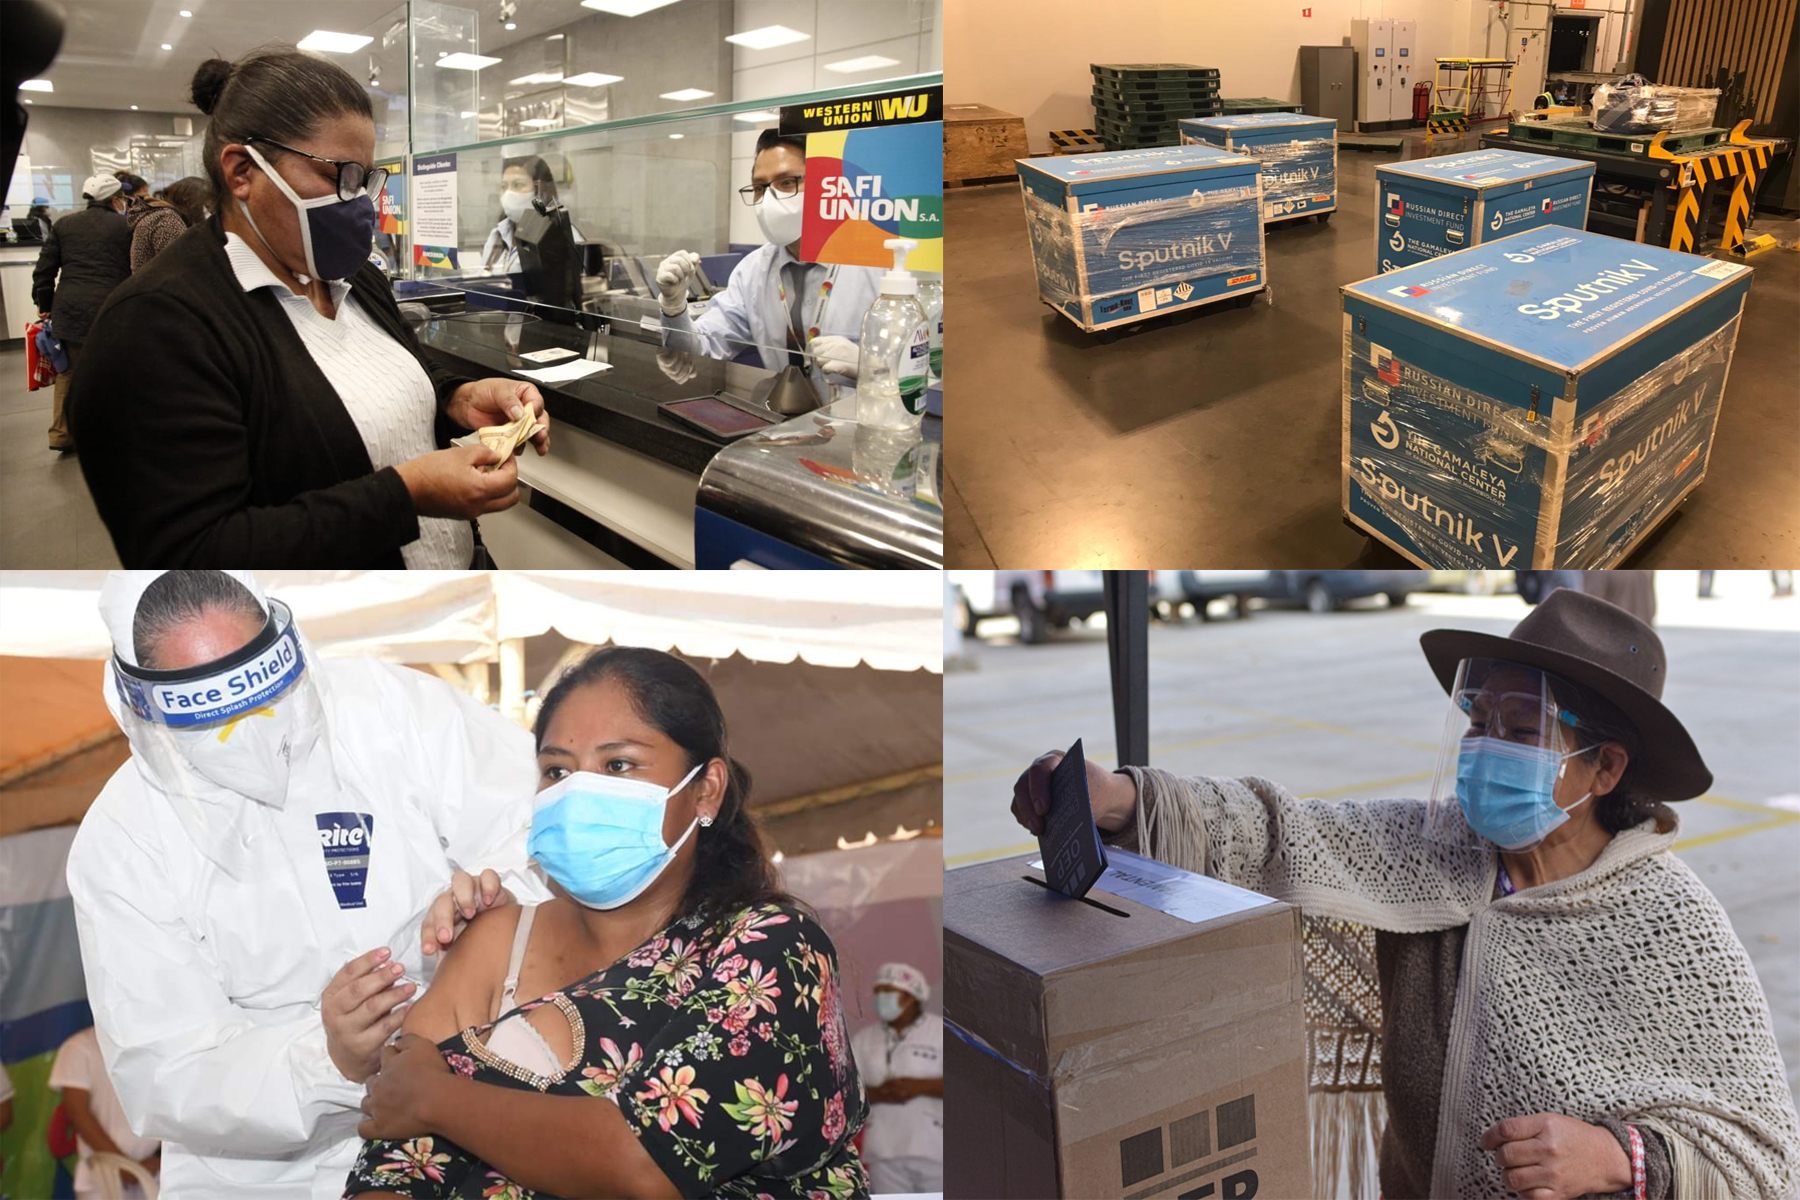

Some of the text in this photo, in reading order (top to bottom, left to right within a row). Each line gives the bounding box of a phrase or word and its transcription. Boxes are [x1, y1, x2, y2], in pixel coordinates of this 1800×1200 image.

[804, 101, 872, 118] WESTERN
[823, 112, 872, 126] UNION
[881, 94, 928, 120] WU
[820, 175, 882, 198] SAFI
[1262, 166, 1319, 188] putnik V
[382, 195, 394, 205] SAFI
[382, 204, 402, 215] UNION
[820, 198, 940, 222] UNION S.A.
[1105, 198, 1162, 211] RUSSIAN DIRECT
[1406, 202, 1465, 221] RUSSIAN DIRECT
[1514, 205, 1536, 214] GAMALEYA
[1552, 197, 1569, 205] RUSSIAN
[1405, 211, 1465, 230] INVESTMENT FUND
[1504, 213, 1522, 221] NATIONAL
[1118, 232, 1232, 271] Sputnik V
[1407, 244, 1434, 256] NATIONAL
[1036, 257, 1070, 292] Sputnik
[1152, 266, 1186, 277] REGISTERED
[1232, 276, 1253, 284] DHL
[1420, 263, 1487, 287] RUSSIAN DIRECT
[1430, 266, 1499, 290] INVESTMENT FUND
[1518, 258, 1659, 320] Sputnik V
[1566, 270, 1686, 329] THE FIRST REGISTERED COVID-19 VACCINE
[1582, 273, 1698, 334] PROVEN HUMAN ADENOVIRAL VECTOR TECHNOLOGY
[1404, 366, 1461, 400] RUSSIAN
[1403, 381, 1479, 424] INVESTMENT
[1599, 400, 1690, 495] Sputnik
[1694, 383, 1707, 414] V
[1405, 441, 1506, 501] NATIONAL CENTER
[1406, 430, 1507, 491] THE GAMALEYA
[1462, 481, 1506, 507] MICROBIOLOGY
[1360, 457, 1484, 553] Sputnik
[1492, 533, 1519, 567] V
[162, 688, 222, 708] Face
[228, 641, 293, 696] Shield
[194, 679, 284, 720] Direct Splash Protection
[1058, 838, 1080, 880] OEP
